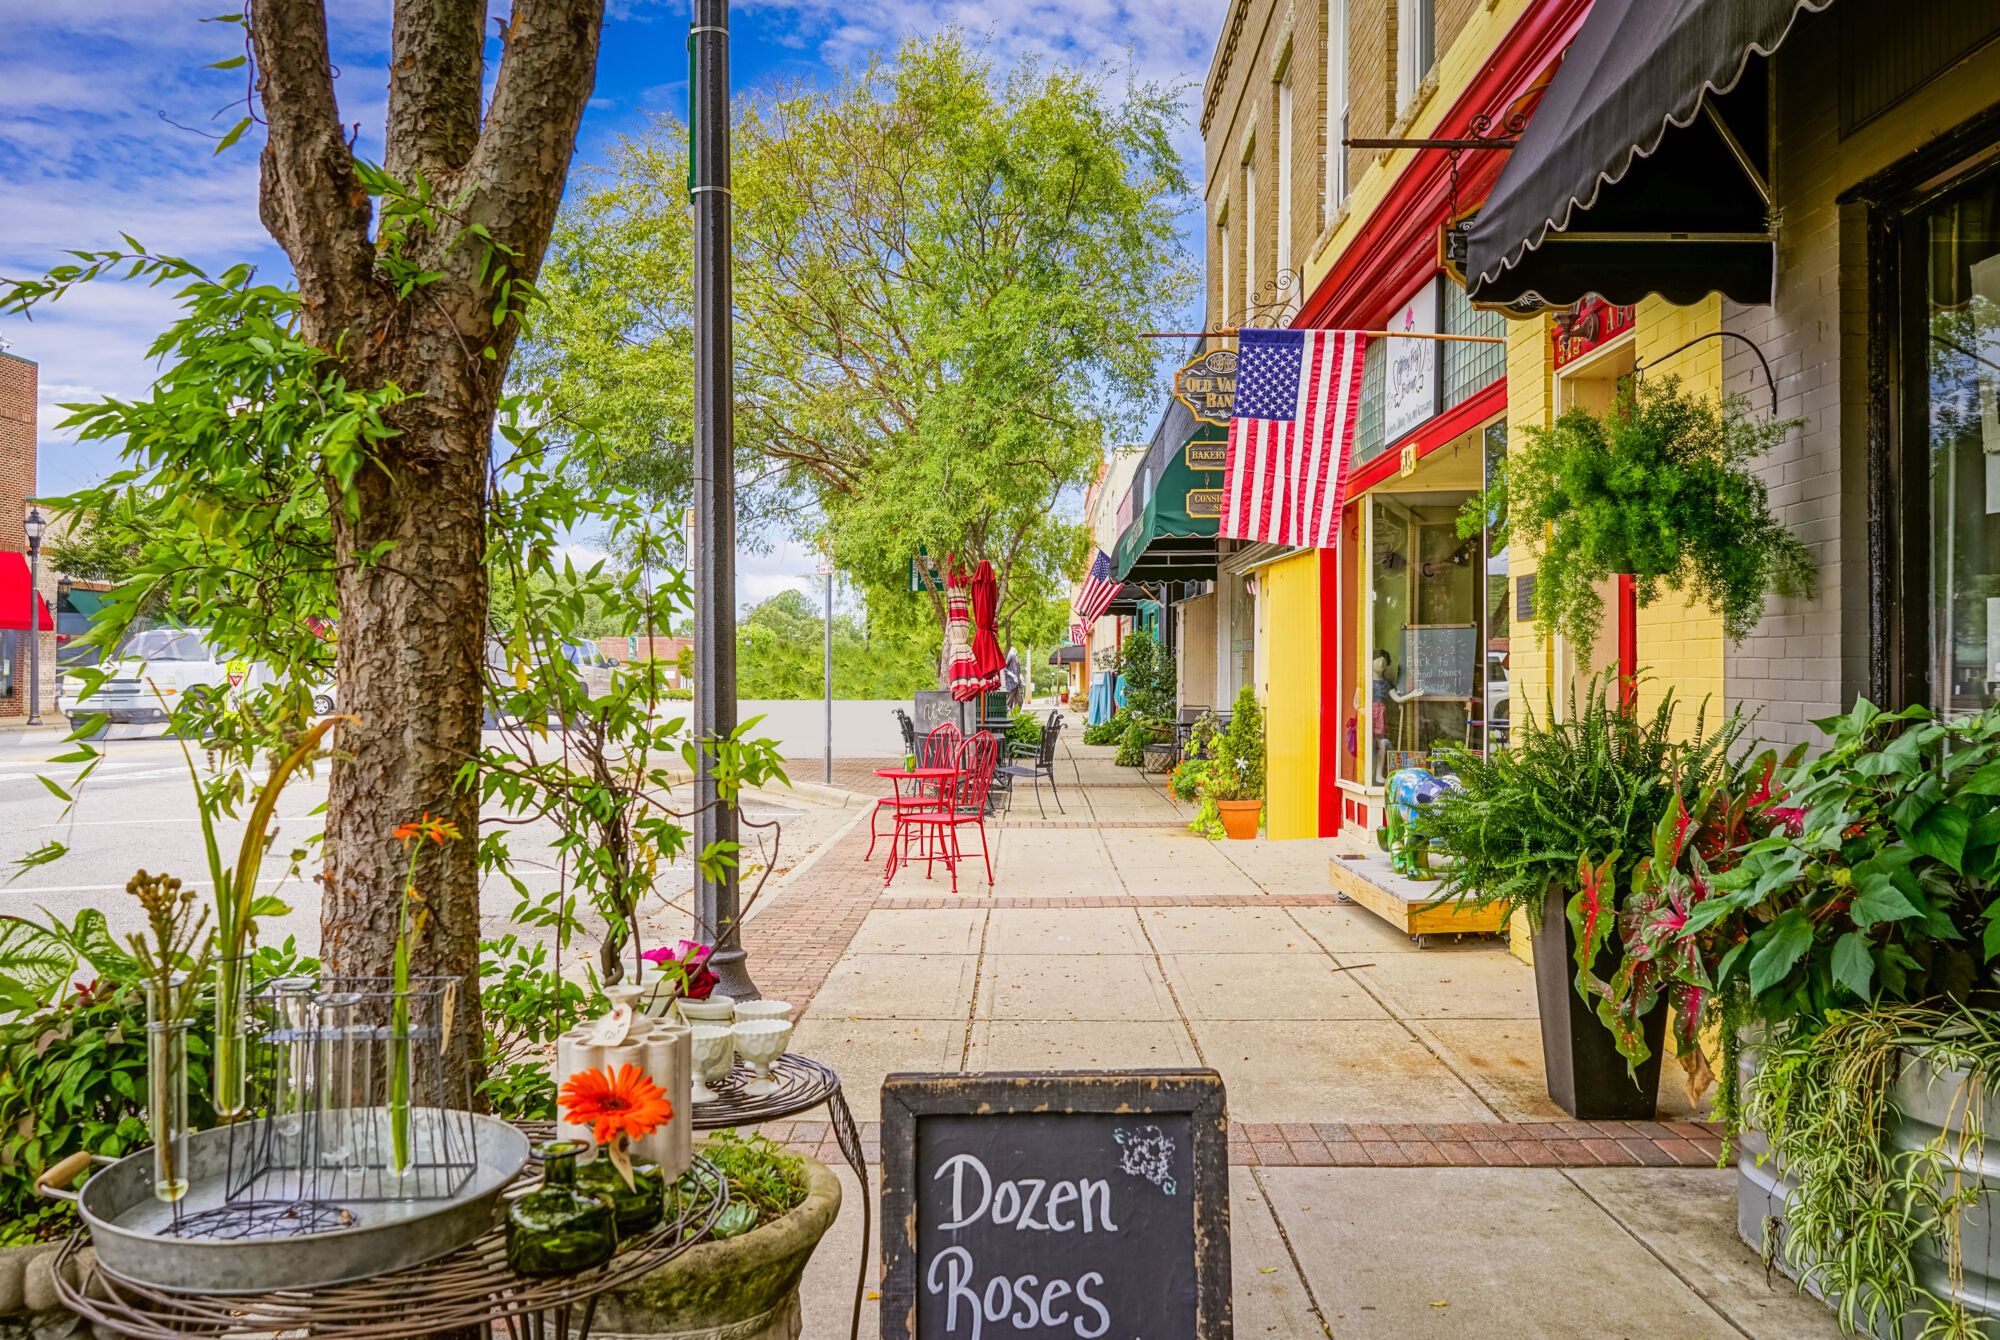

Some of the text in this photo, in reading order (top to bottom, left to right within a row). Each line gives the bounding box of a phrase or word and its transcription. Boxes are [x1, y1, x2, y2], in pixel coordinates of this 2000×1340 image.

[1185, 377, 1212, 393] OLD
[1206, 392, 1235, 408] BAN
[1192, 450, 1227, 460] BAKERY
[934, 1153, 1118, 1233] Dozen
[927, 1245, 1110, 1340] Roses
